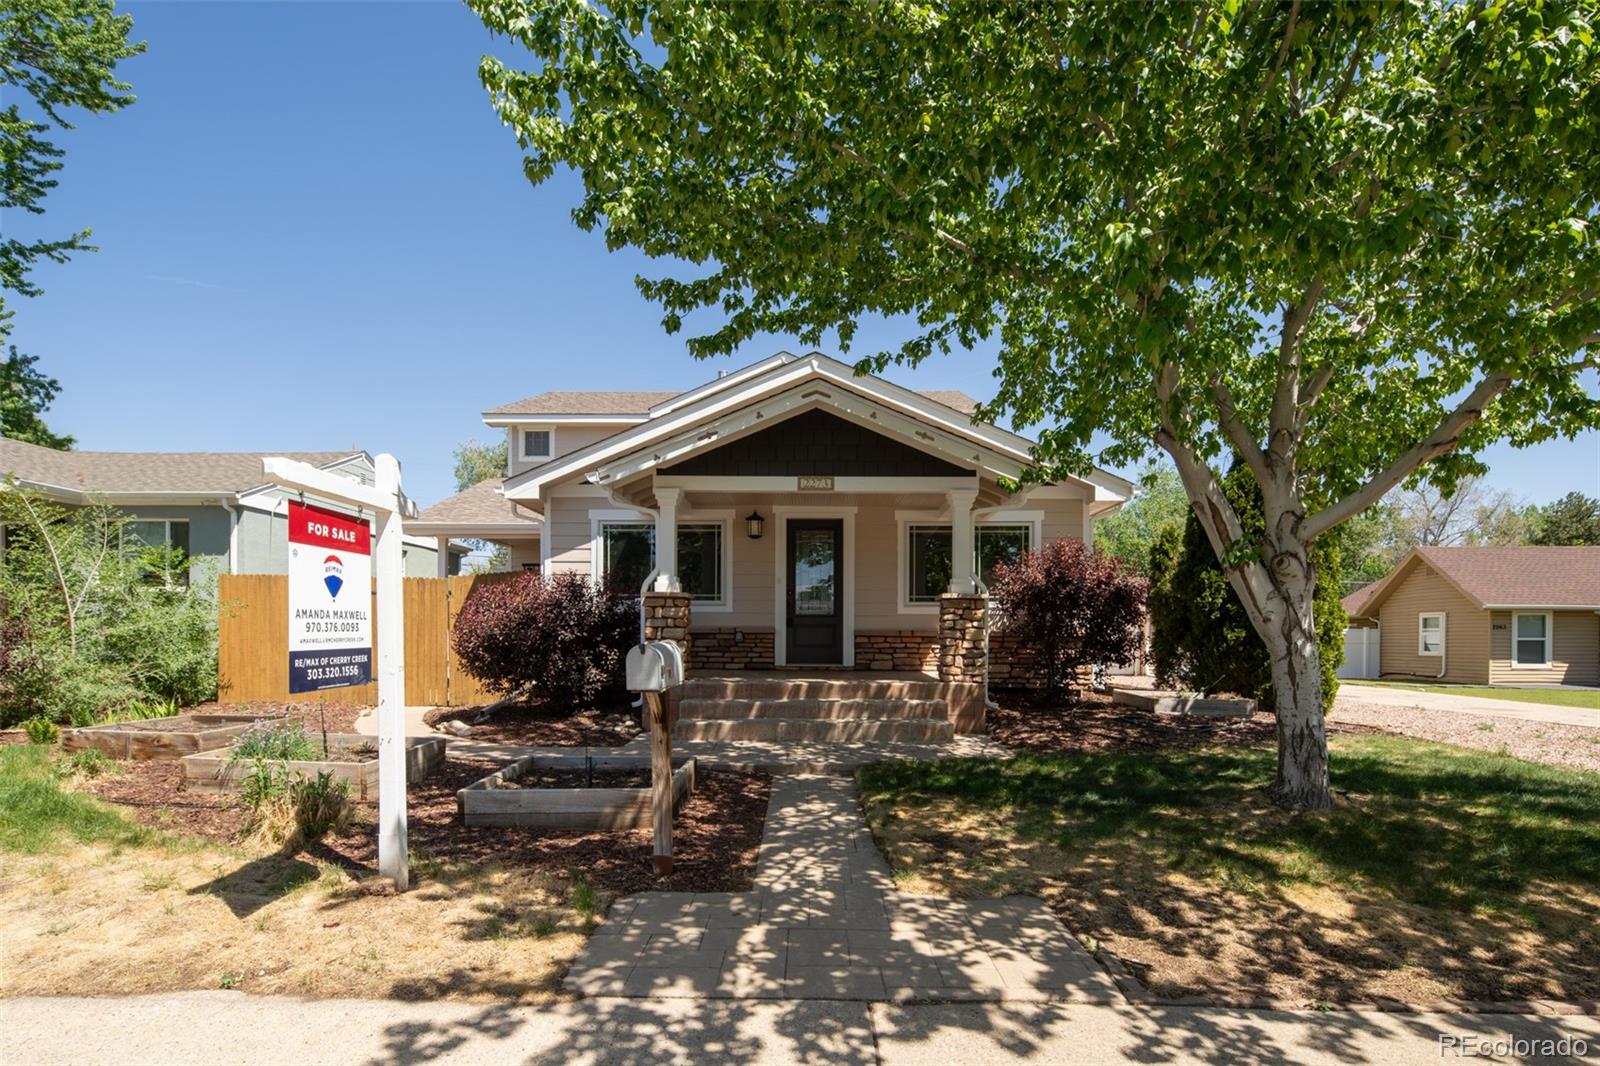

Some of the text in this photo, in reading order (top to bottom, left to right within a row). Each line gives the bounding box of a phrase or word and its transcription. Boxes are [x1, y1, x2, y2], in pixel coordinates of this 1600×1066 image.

[307, 522, 356, 542] FOR SALE
[295, 608, 367, 620] AMANDA MAXWELL
[305, 622, 359, 633] 970.376.0093
[294, 655, 368, 668] RE/MAX OF CHERRY CREEK
[306, 665, 359, 680] 303.320.1556
